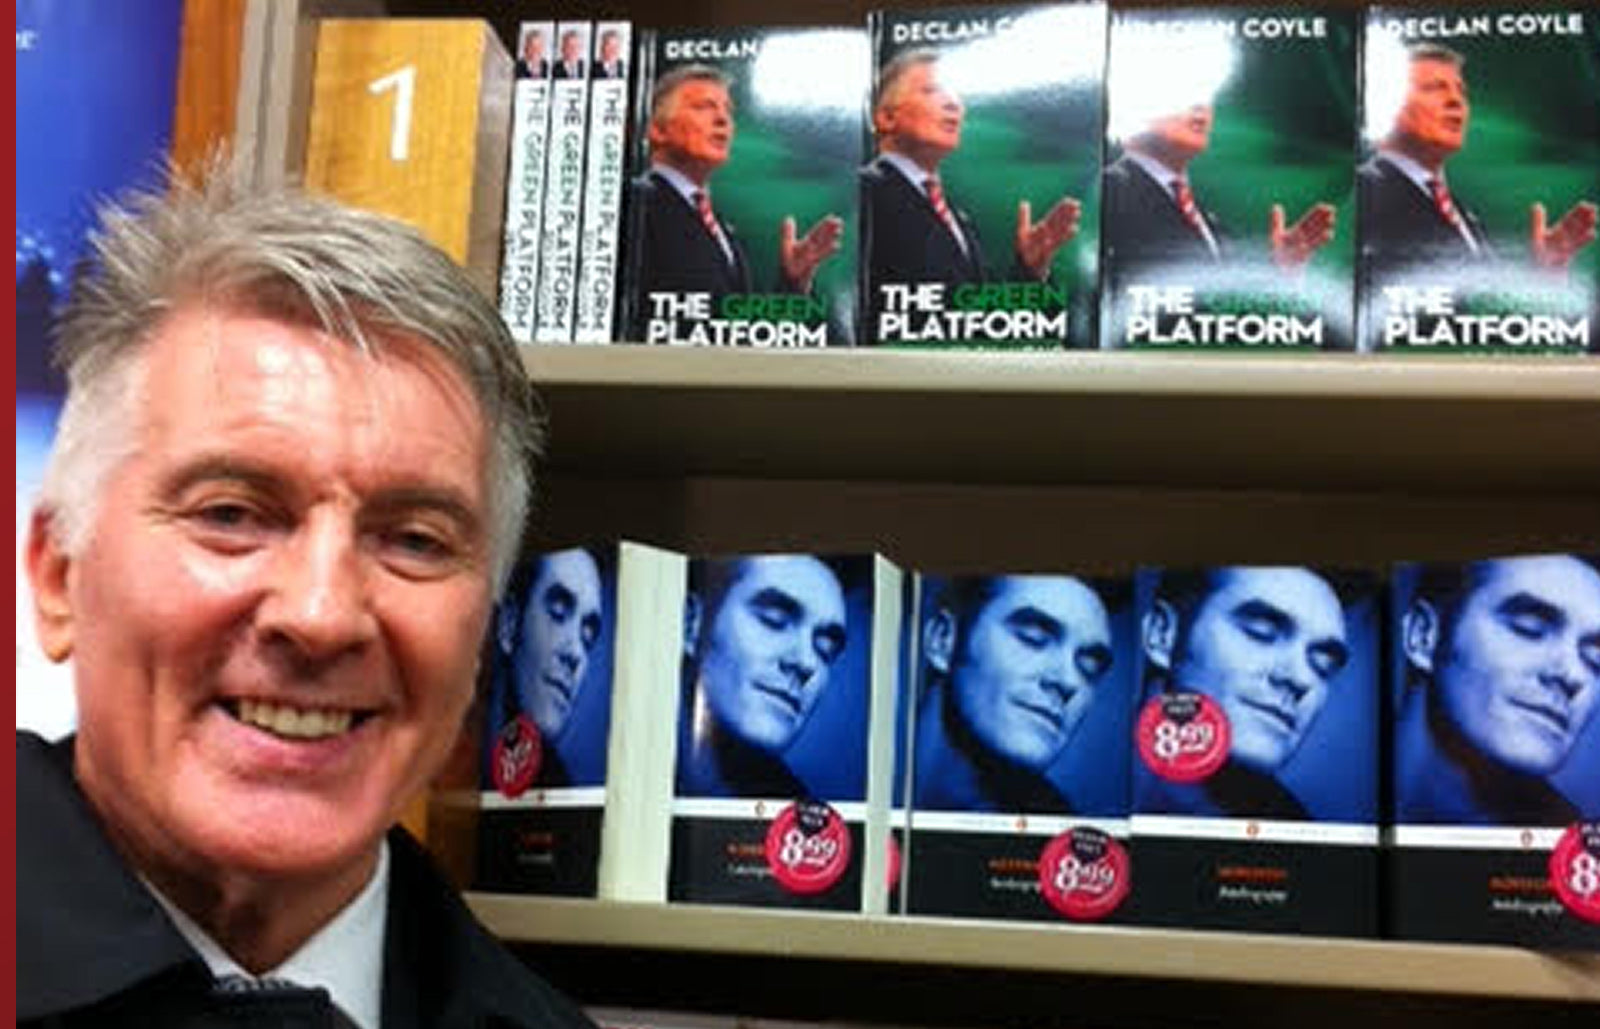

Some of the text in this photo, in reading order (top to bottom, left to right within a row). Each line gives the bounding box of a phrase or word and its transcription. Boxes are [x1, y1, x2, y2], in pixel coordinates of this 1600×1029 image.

[894, 19, 989, 42] DECLAN
[1242, 17, 1326, 38] COYLE
[1386, 13, 1584, 38] DECLAN COYLE
[666, 39, 758, 59] DECLAN
[368, 63, 417, 161] 1
[513, 87, 545, 328] THE GREEN PLATFORM
[552, 87, 583, 329] THE GREEN PLATFORM
[592, 87, 622, 331] THE GREEN PLATFORM
[650, 292, 828, 319] THE GREEN
[880, 283, 1066, 312] THE GREEN
[1126, 284, 1195, 314] THE
[1384, 285, 1454, 315] THE
[648, 319, 828, 347] PLATFORM
[879, 310, 1067, 341] PLATFORM
[1125, 314, 1324, 345] PLATFORM
[1384, 315, 1591, 346] PLATFORM
